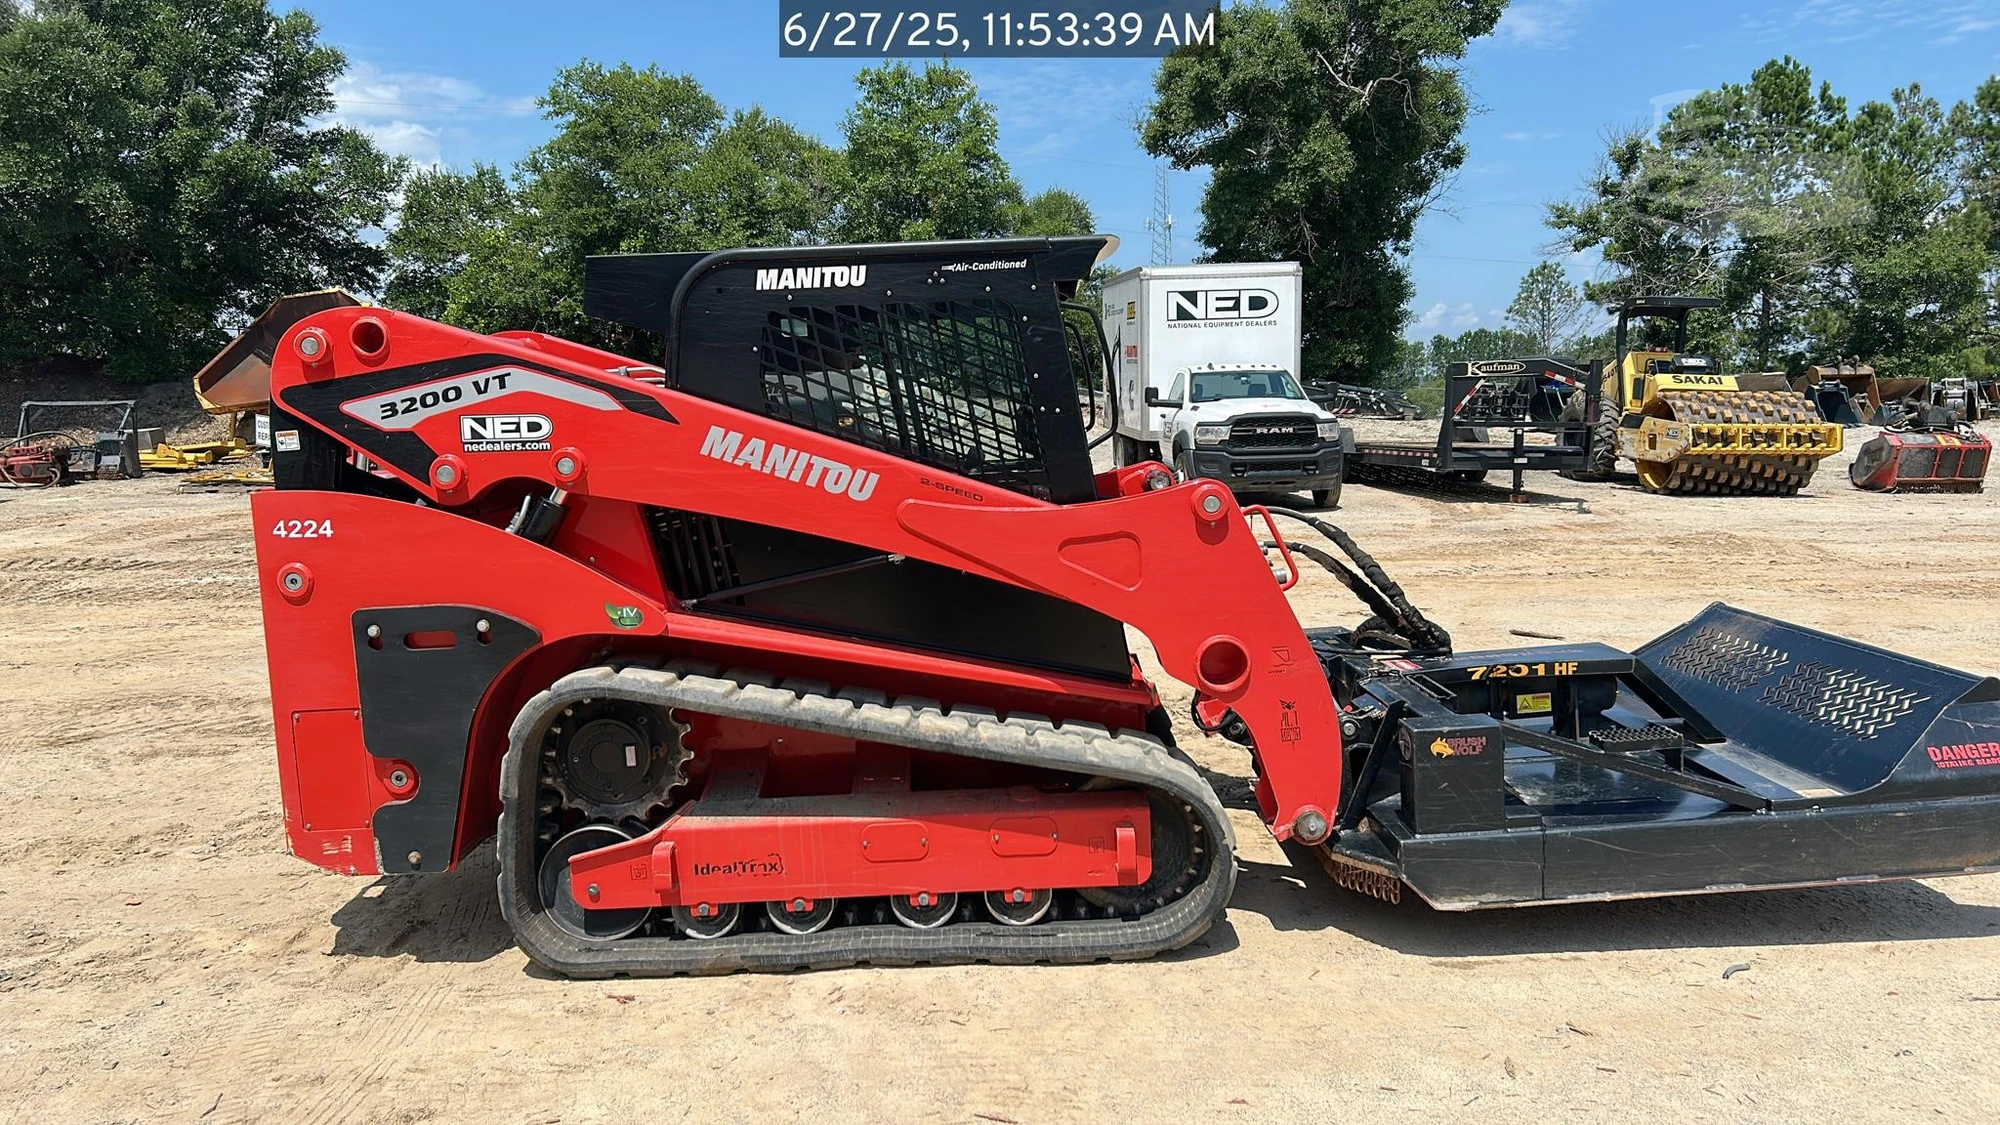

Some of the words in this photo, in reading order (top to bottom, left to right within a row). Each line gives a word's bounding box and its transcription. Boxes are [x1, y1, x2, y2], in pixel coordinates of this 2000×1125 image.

[954, 259, 1027, 272] Air-Conditioned
[756, 265, 867, 291] MANITOU
[1167, 288, 1279, 321] NED
[1203, 320, 1244, 328] EQUIPMENT
[1245, 319, 1278, 327] DEALERS
[1466, 361, 1521, 377] Kaufman
[1672, 375, 1723, 386] SAKAI
[380, 385, 463, 420] 3200
[471, 372, 512, 396] VT
[257, 431, 270, 441] REP
[461, 414, 553, 442] NED
[1256, 427, 1294, 435] RAM
[463, 440, 551, 452] nedealers.com
[701, 425, 880, 501] MANITOU
[921, 477, 984, 502] 2-SPEED
[272, 519, 334, 538] 4224
[1466, 663, 1546, 681] 7201
[1554, 662, 1579, 676] HF
[1447, 736, 1487, 747] BRUSH
[1451, 744, 1483, 755] WOLF
[1926, 742, 2000, 762] DANGER
